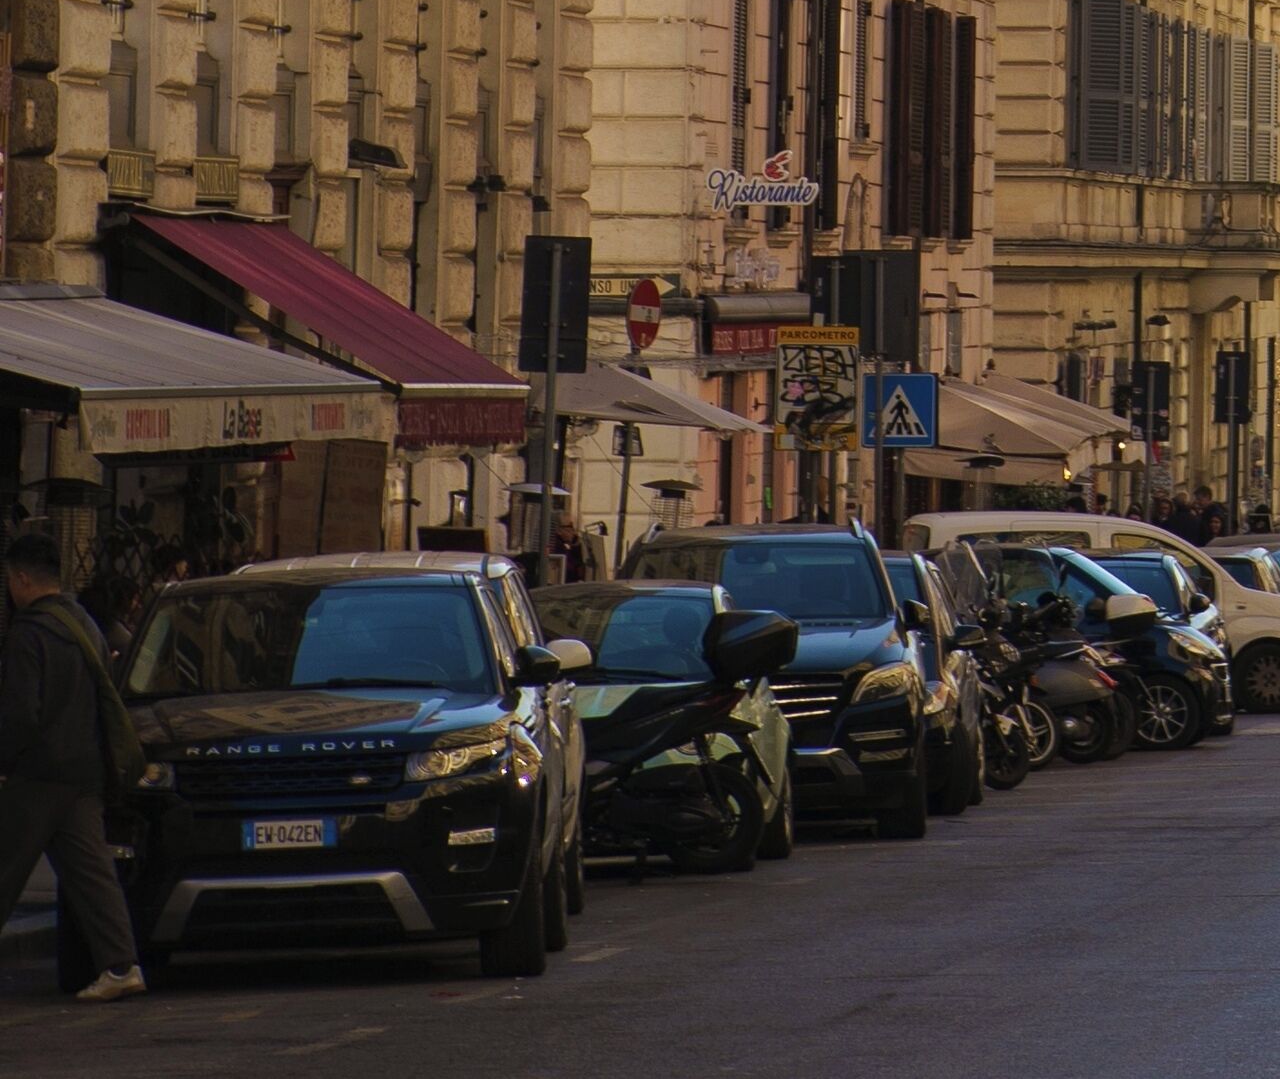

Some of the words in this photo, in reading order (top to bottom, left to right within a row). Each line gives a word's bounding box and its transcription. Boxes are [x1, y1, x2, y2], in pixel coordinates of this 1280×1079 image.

[708, 169, 818, 211] Ristorante
[780, 330, 856, 340] PARCOMETRO
[186, 743, 281, 756] RANGE
[301, 738, 396, 752] ROVER
[255, 826, 274, 845] EW
[277, 824, 322, 844] 042EN
